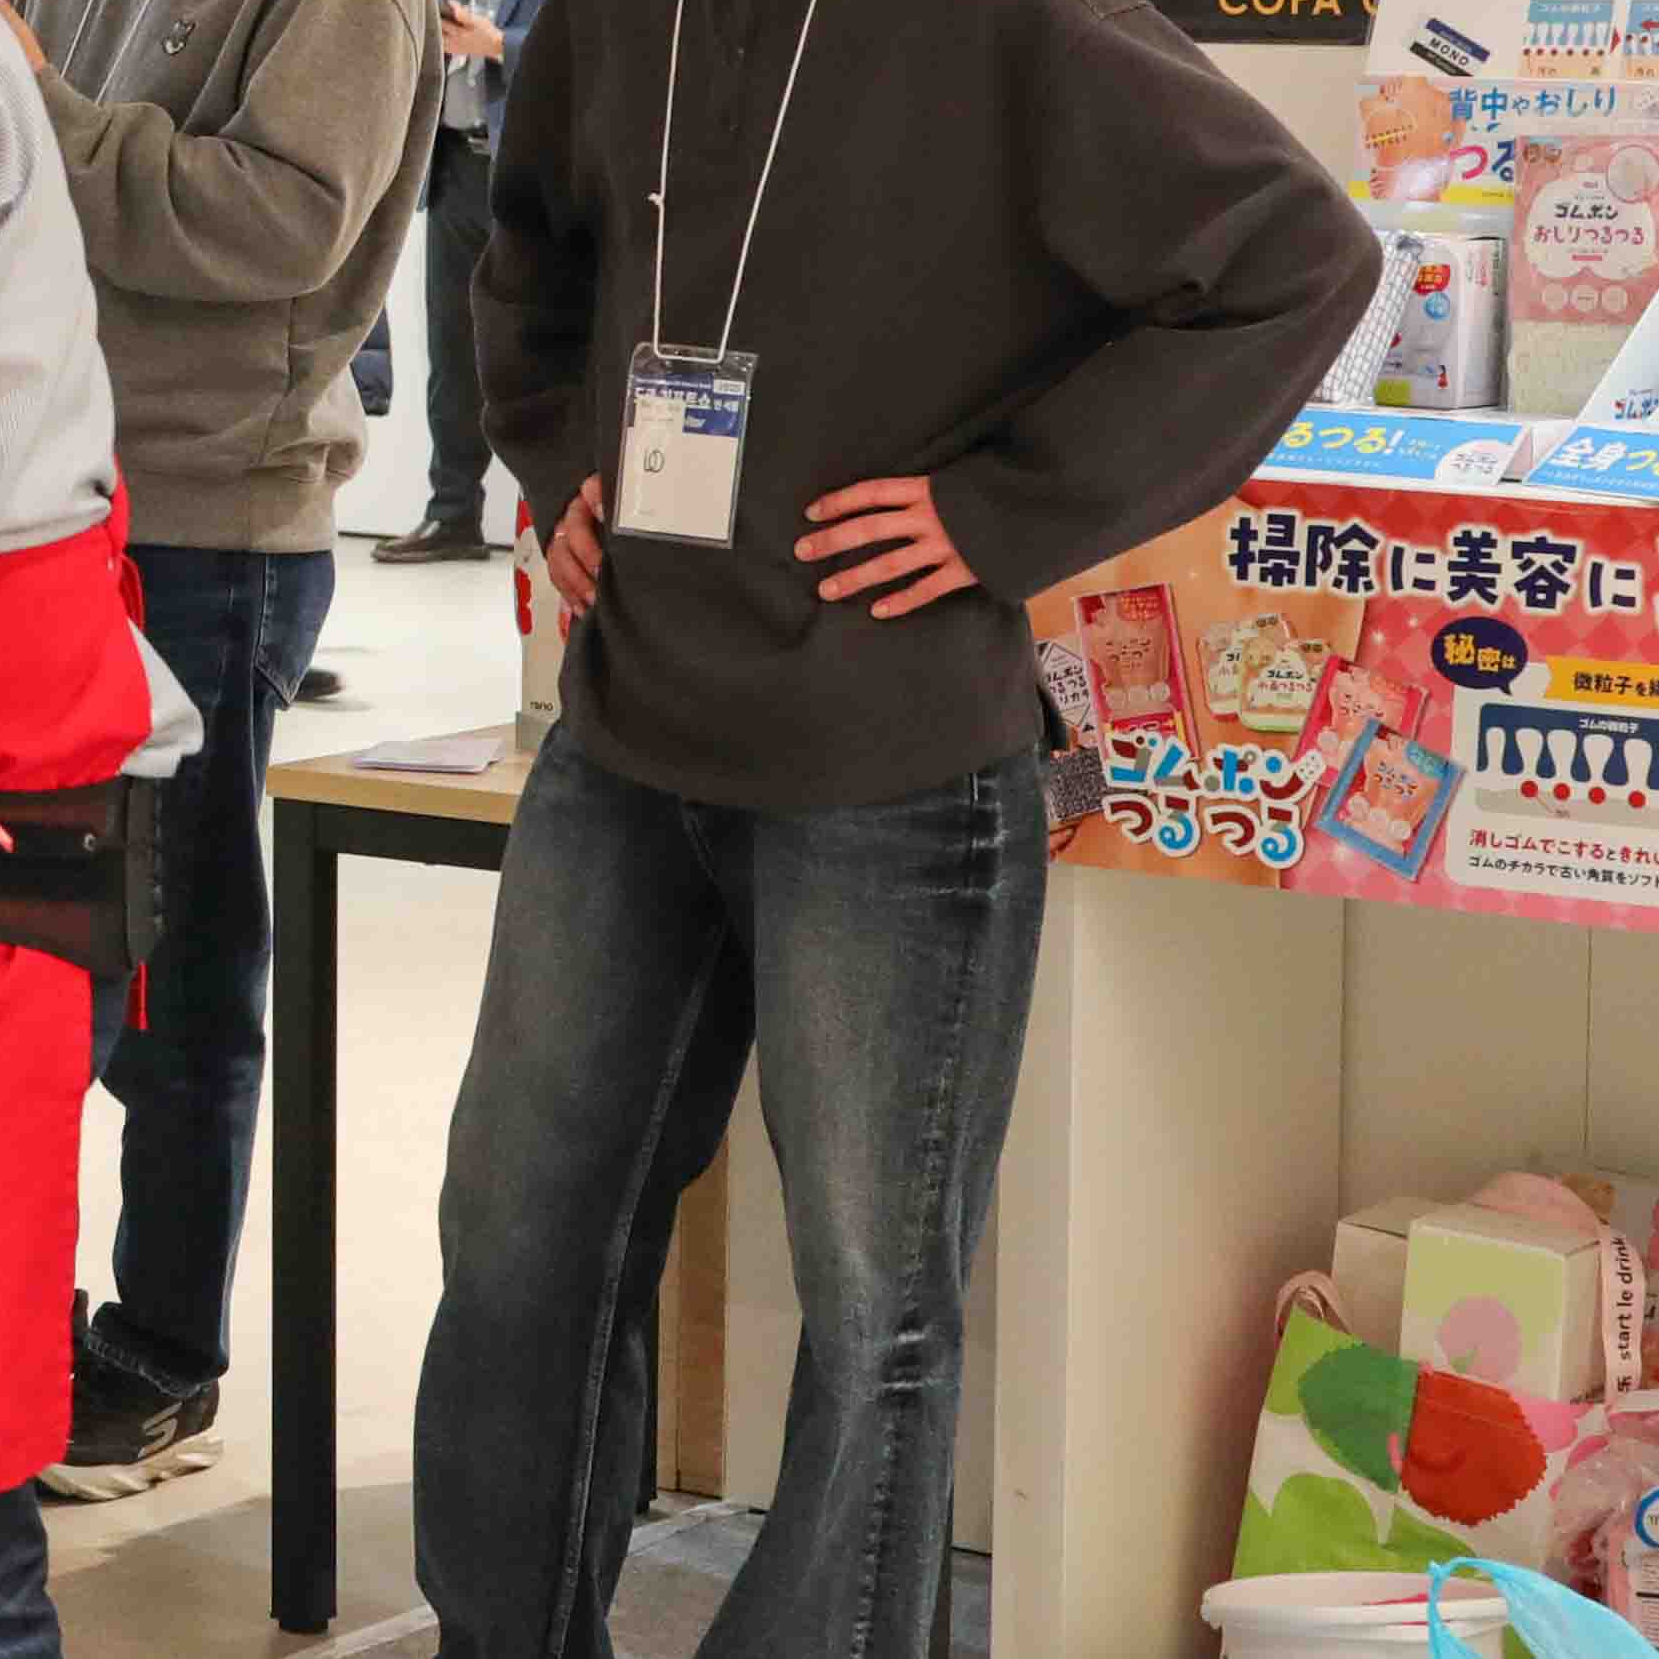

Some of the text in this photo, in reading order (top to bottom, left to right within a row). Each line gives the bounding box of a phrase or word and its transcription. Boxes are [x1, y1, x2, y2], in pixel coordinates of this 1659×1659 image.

[1429, 38, 1470, 68] MONO
[1533, 225, 1644, 245] おしりつるつる
[1547, 436, 1659, 476] 全身つ
[1228, 512, 1638, 610] 掃除に美容に
[1443, 632, 1516, 673] 秘密は
[1110, 737, 1306, 801] ゴムポン
[1110, 795, 1298, 864] つるつる
